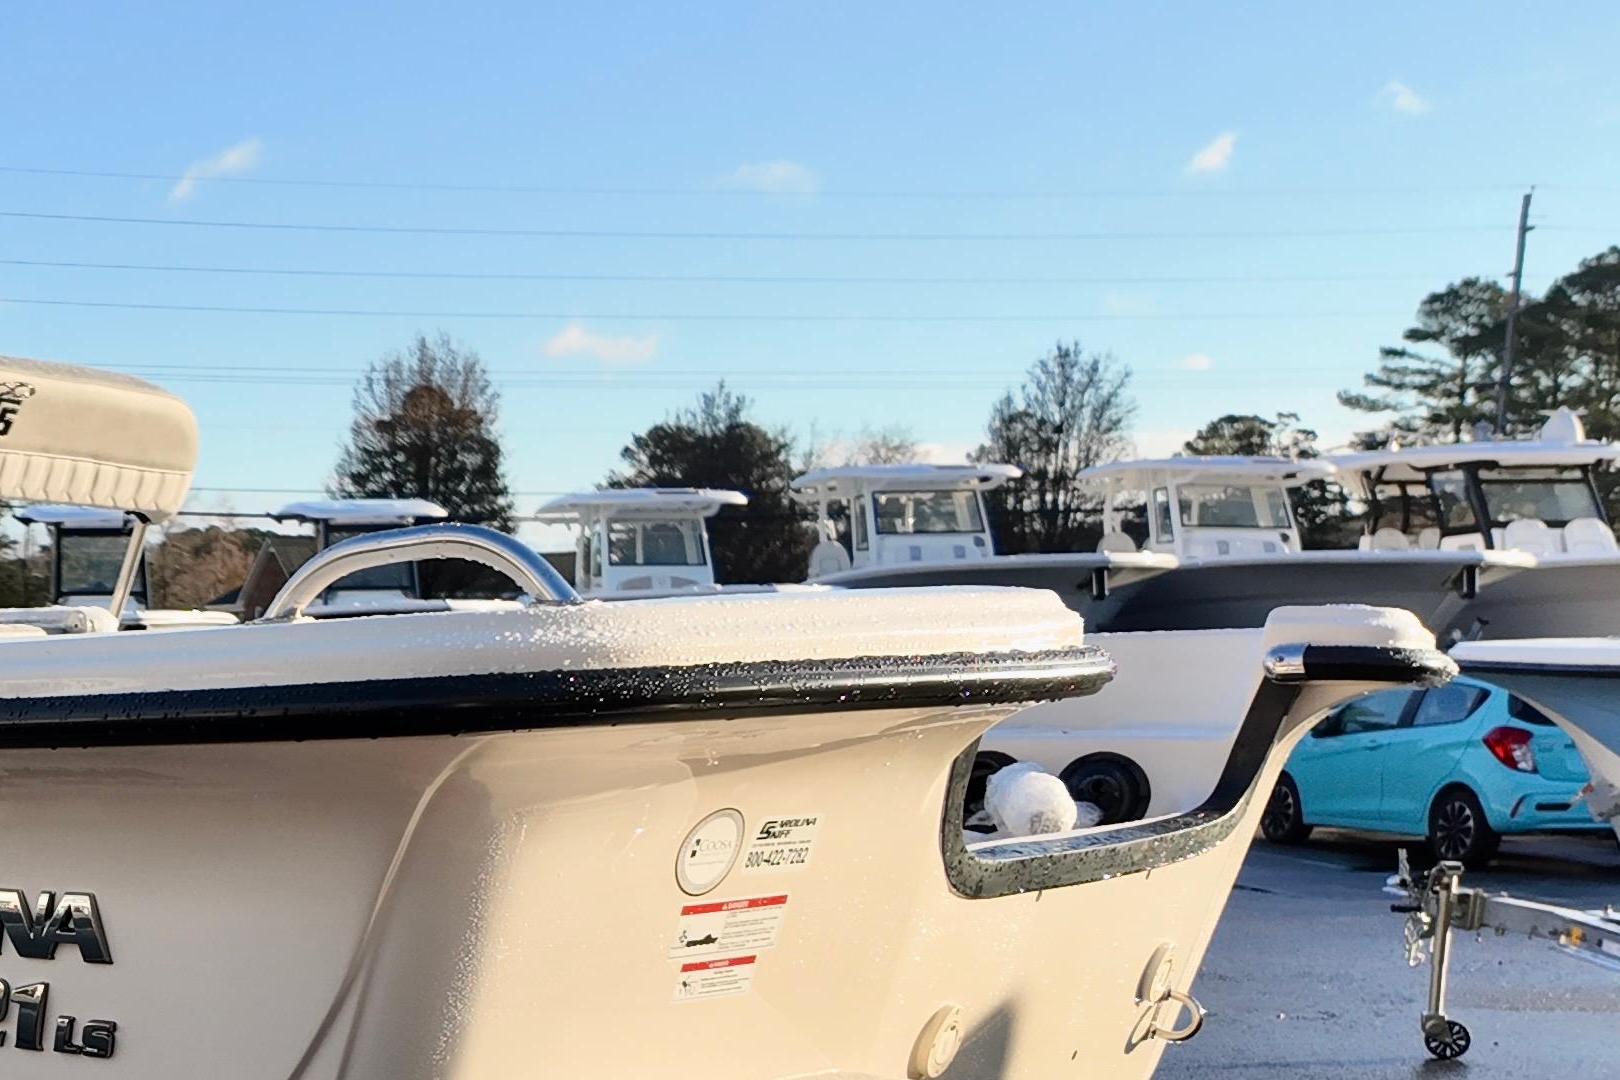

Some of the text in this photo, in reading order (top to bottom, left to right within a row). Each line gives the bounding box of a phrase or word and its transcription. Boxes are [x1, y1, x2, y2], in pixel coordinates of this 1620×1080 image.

[755, 826, 792, 841] SKIFF
[759, 817, 818, 834] CAROLINA
[53, 1013, 119, 1059] LS
